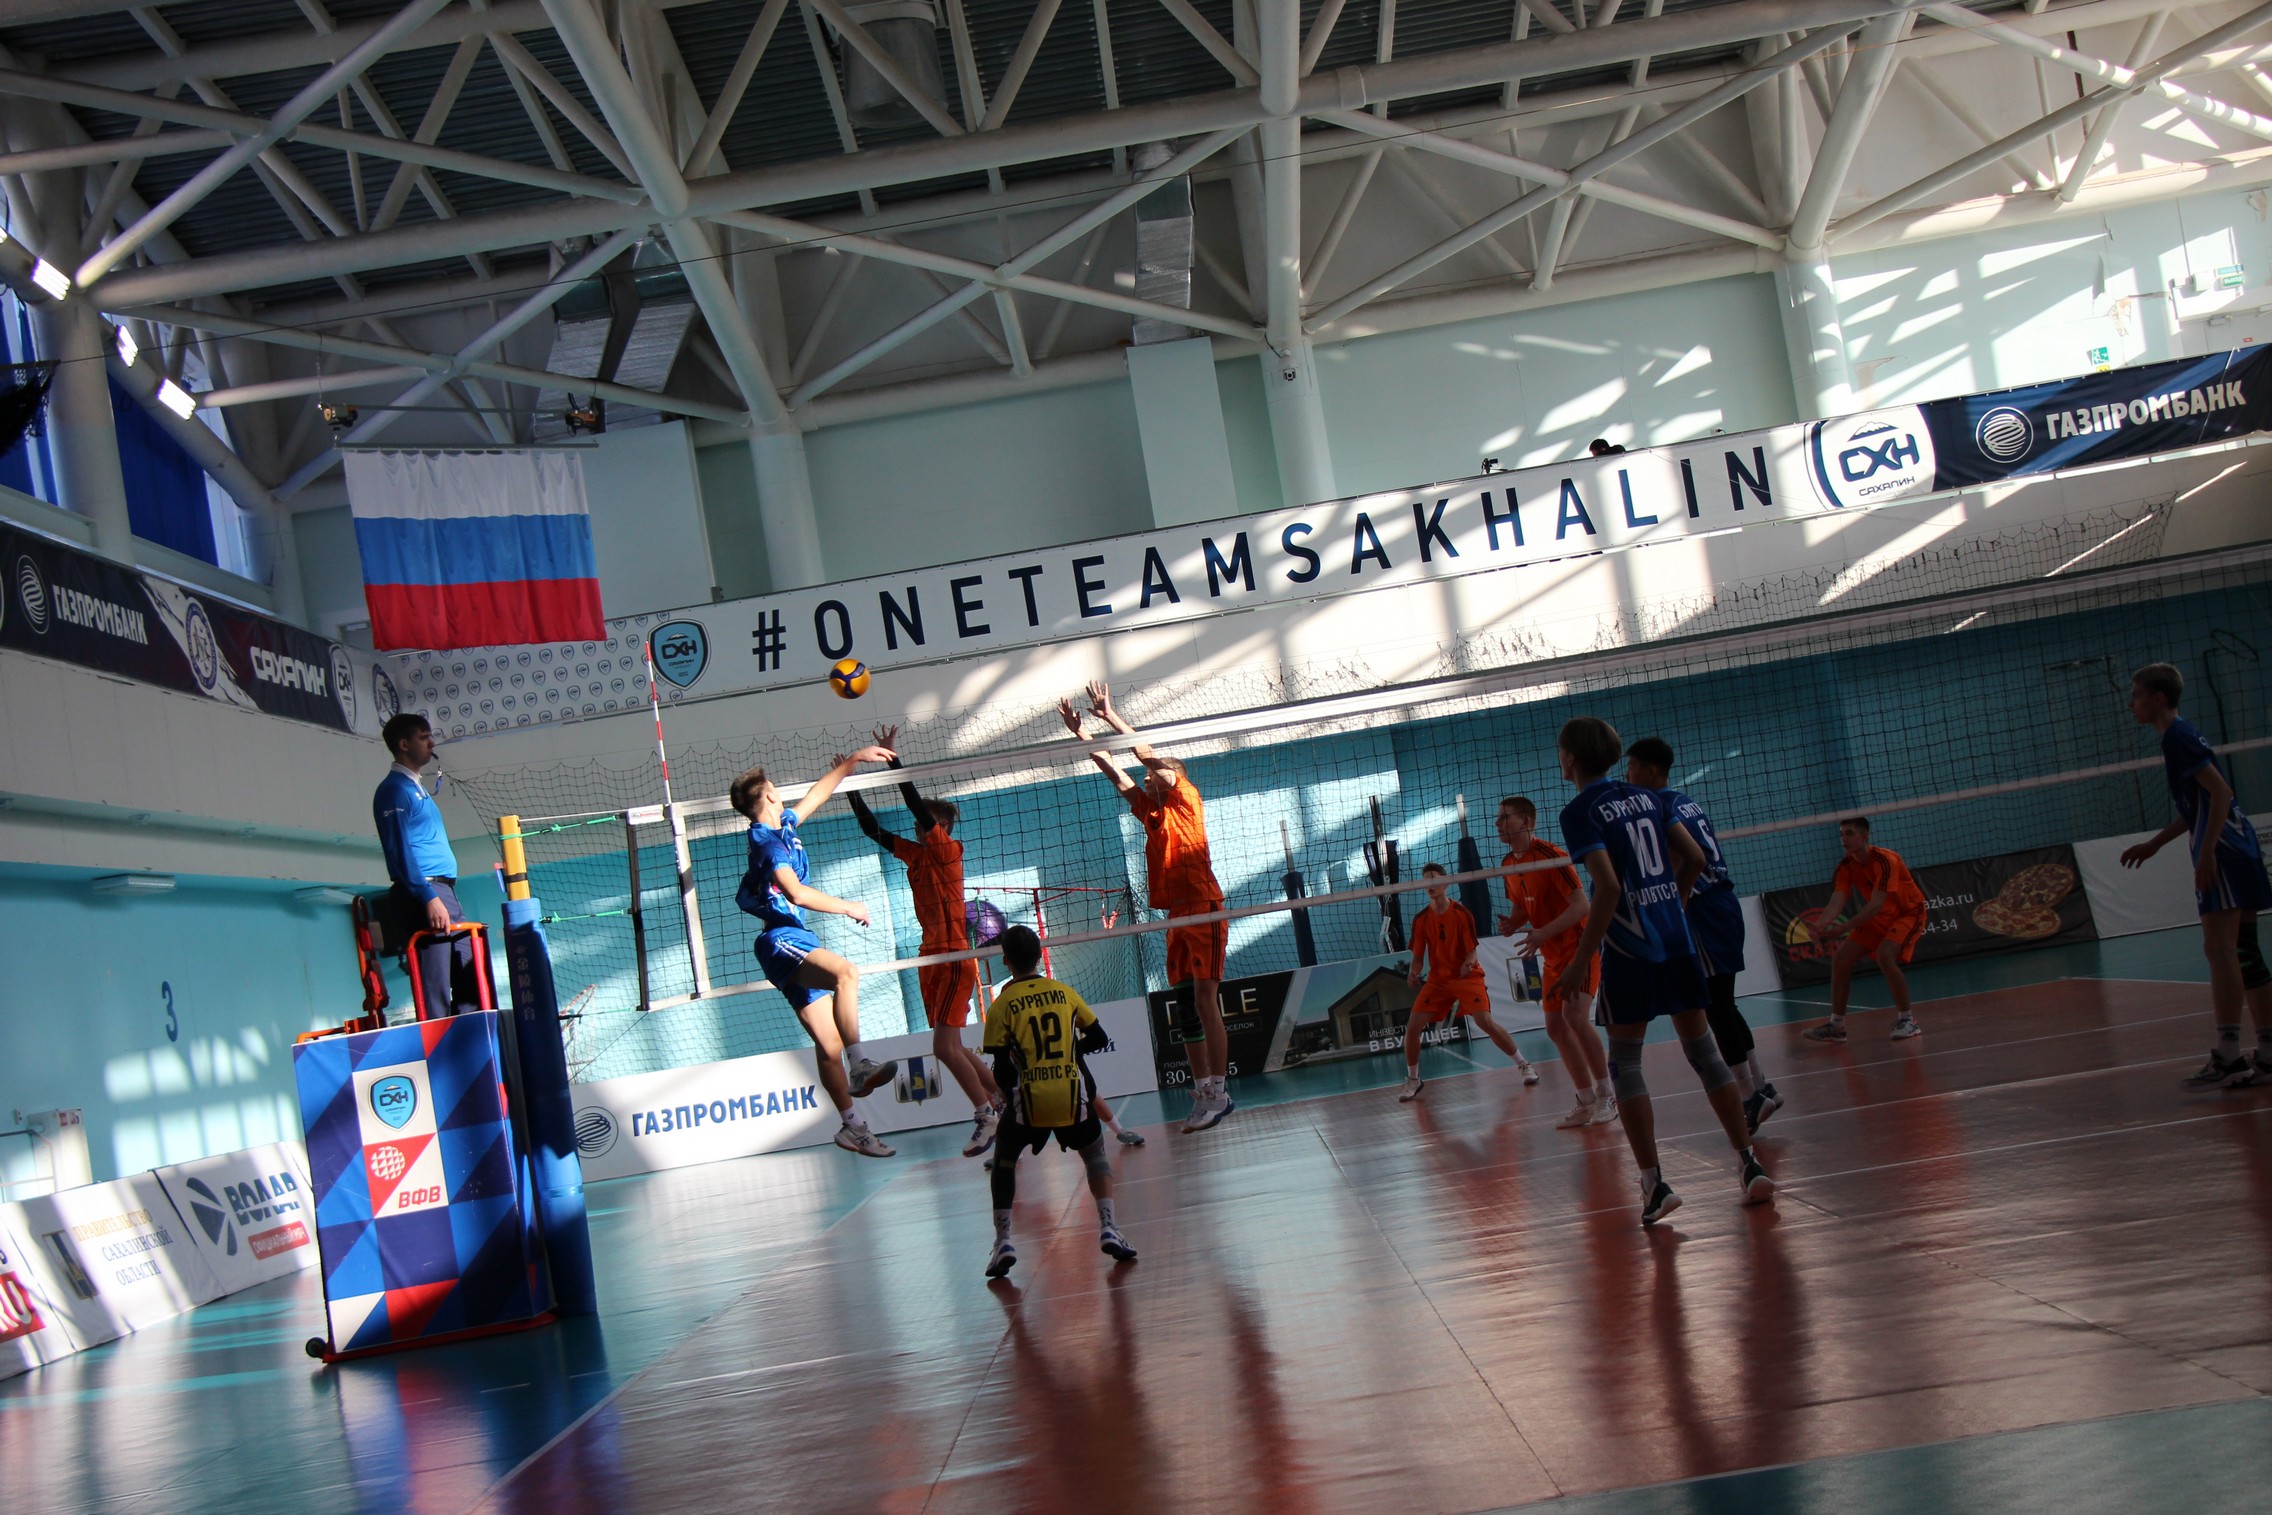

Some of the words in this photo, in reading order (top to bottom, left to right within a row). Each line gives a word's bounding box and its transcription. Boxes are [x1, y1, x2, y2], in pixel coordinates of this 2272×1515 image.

[2046, 380, 2246, 440] ГАЗПРОМБАНК
[1859, 476, 1915, 497] САХАЛИН
[751, 446, 1773, 672] #ONETEAMSAKHALIN
[52, 584, 148, 645] ГАЗПРОМБАНК
[251, 646, 328, 697] САХАЛИН
[1625, 817, 1665, 879] 10
[1923, 893, 1974, 910] azka.ru
[161, 980, 179, 1042] 3
[1008, 990, 1067, 1015] БУРЯТИЯ
[1028, 1011, 1064, 1062] 12
[1369, 1040, 1380, 1052] В
[1384, 1026, 1461, 1050] БУУЩЕЕ
[1021, 1064, 1063, 1083] РЦПВТС
[631, 1084, 819, 1137] ГАЗПРОМБАНК
[398, 1186, 441, 1209] ВФВ
[72, 1208, 153, 1243] ПРАВИТЕЛЬСТВО
[101, 1225, 174, 1262] САХАЛИНСКОЙ
[115, 1259, 163, 1286] ОБЛАСТИ
